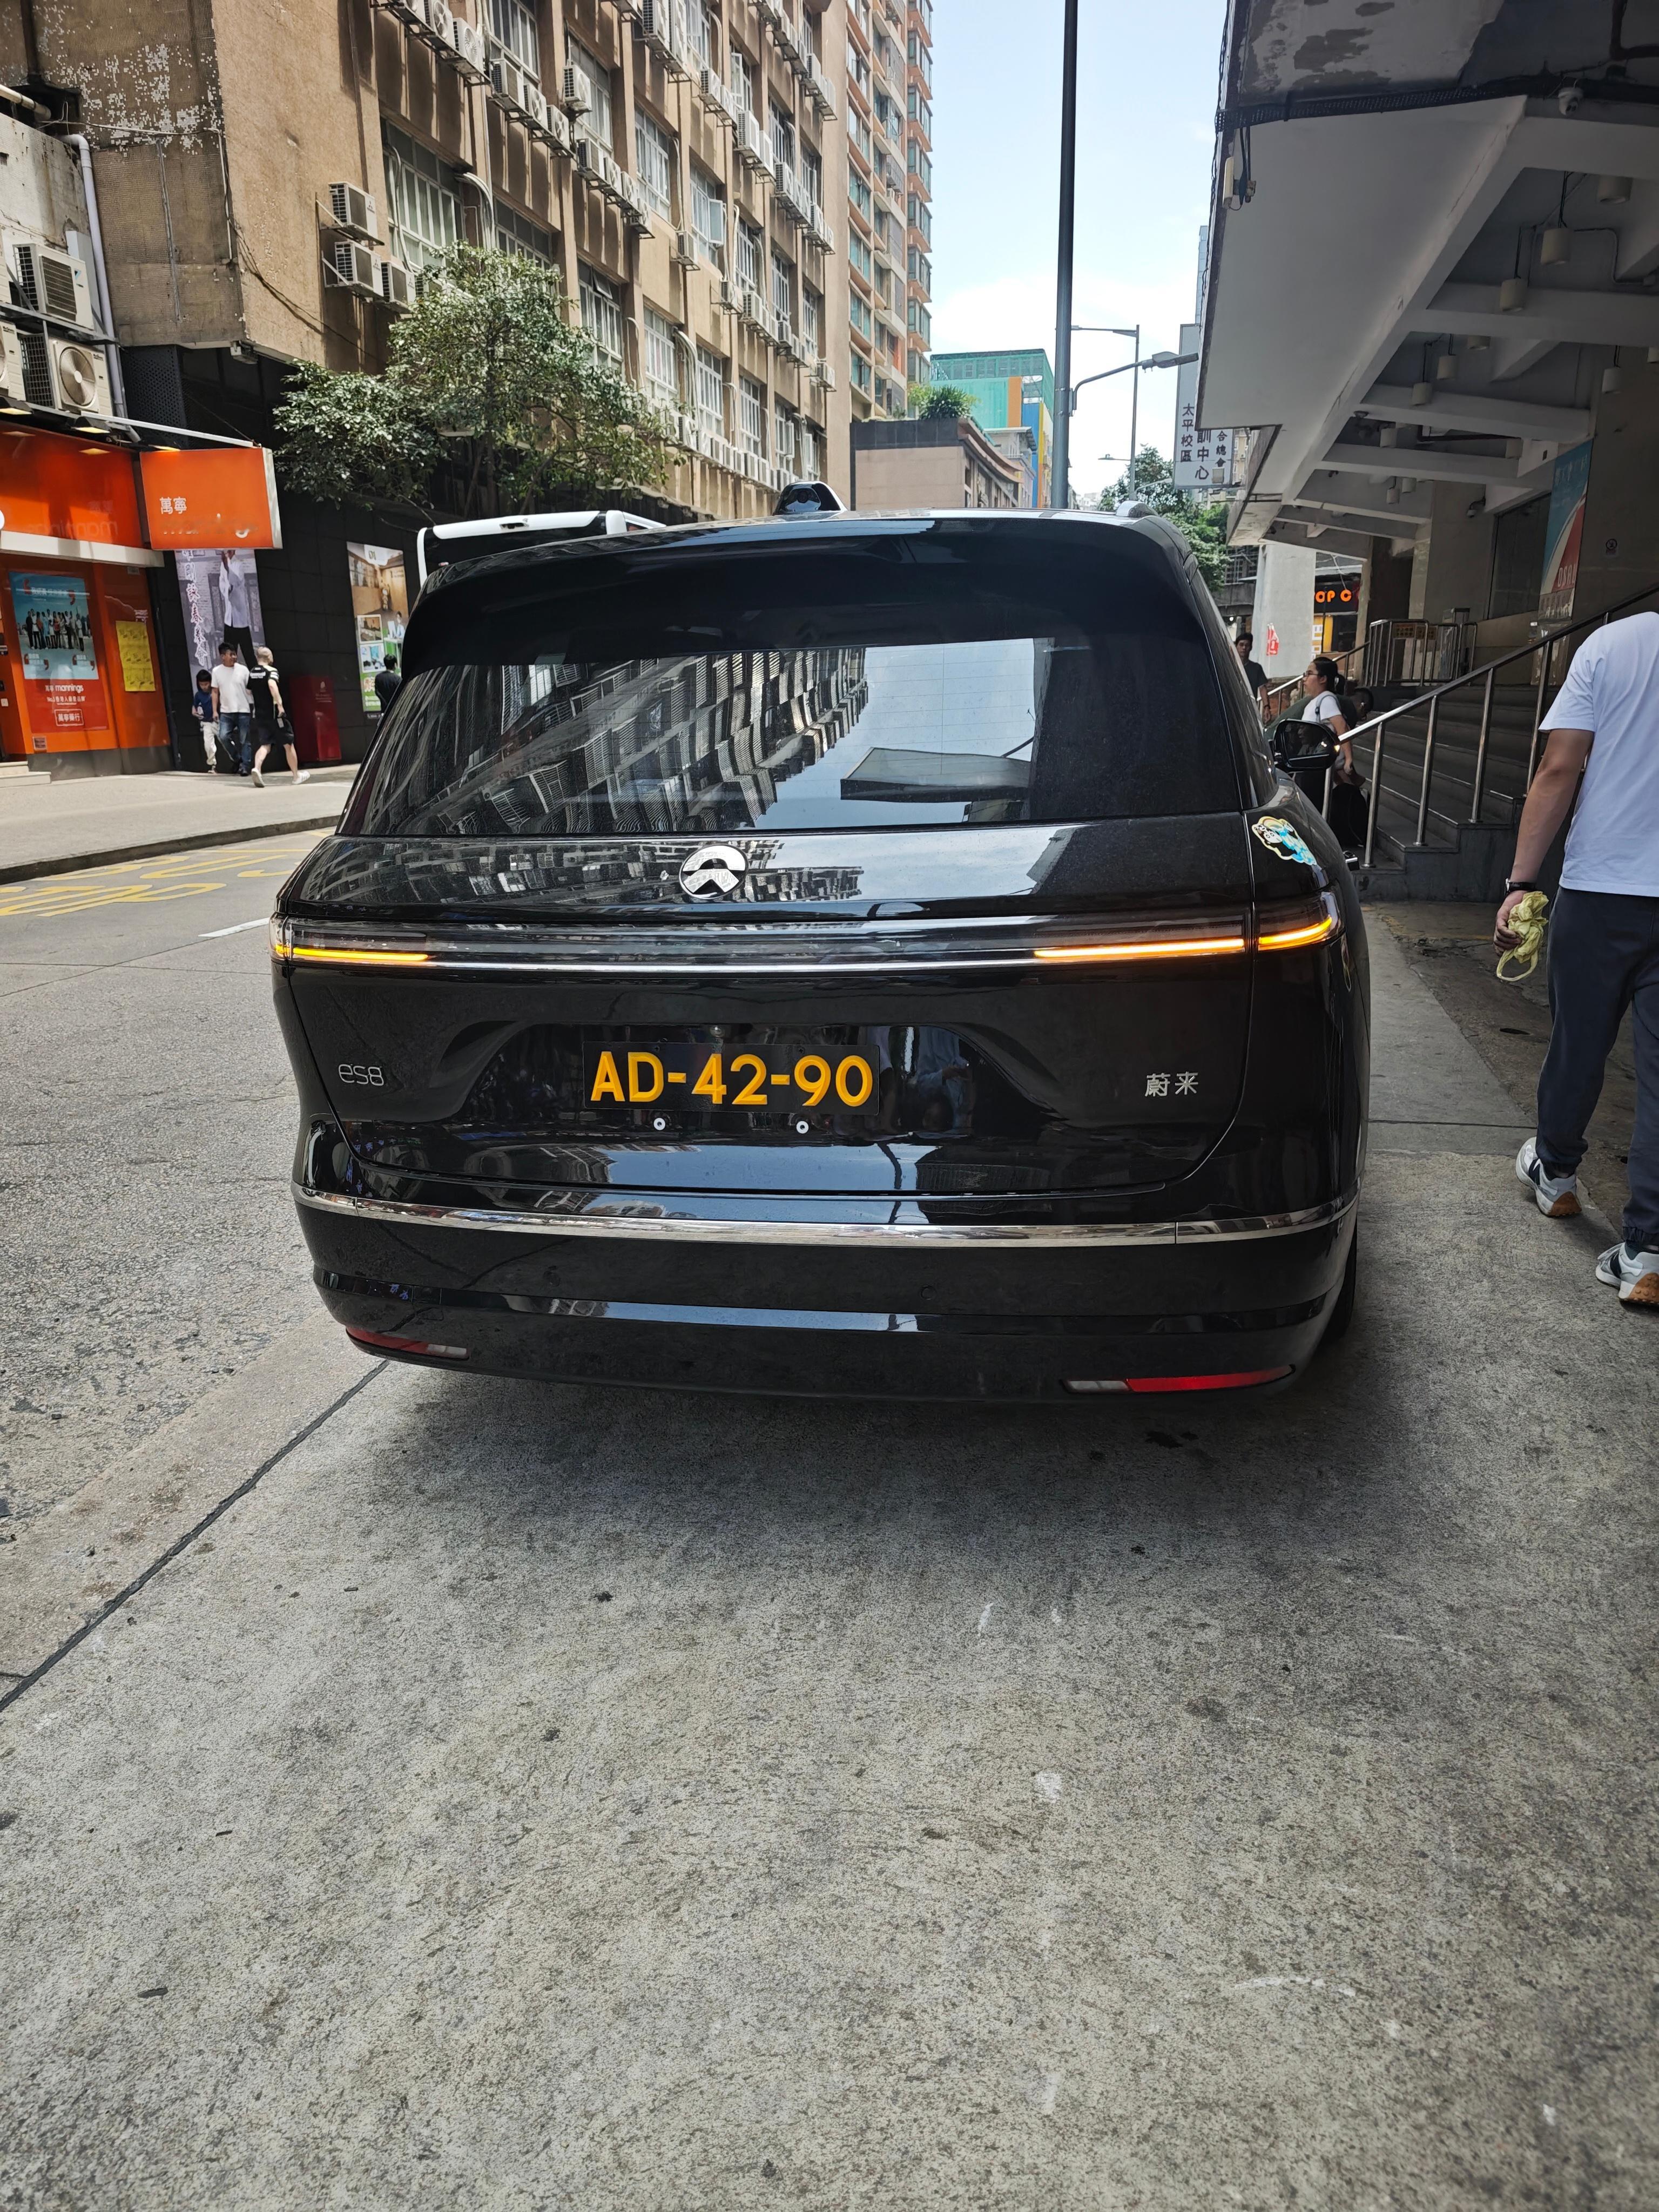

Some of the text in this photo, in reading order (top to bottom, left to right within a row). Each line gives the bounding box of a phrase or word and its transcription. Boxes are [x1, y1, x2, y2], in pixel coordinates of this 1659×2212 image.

[1181, 403, 1194, 462] 太平校區
[1195, 430, 1211, 480] 訓中心
[159, 497, 187, 514] 萬寧
[0, 883, 227, 917] TOP
[591, 1051, 873, 1107] AD-42-90
[1145, 1071, 1198, 1097] 蔚来
